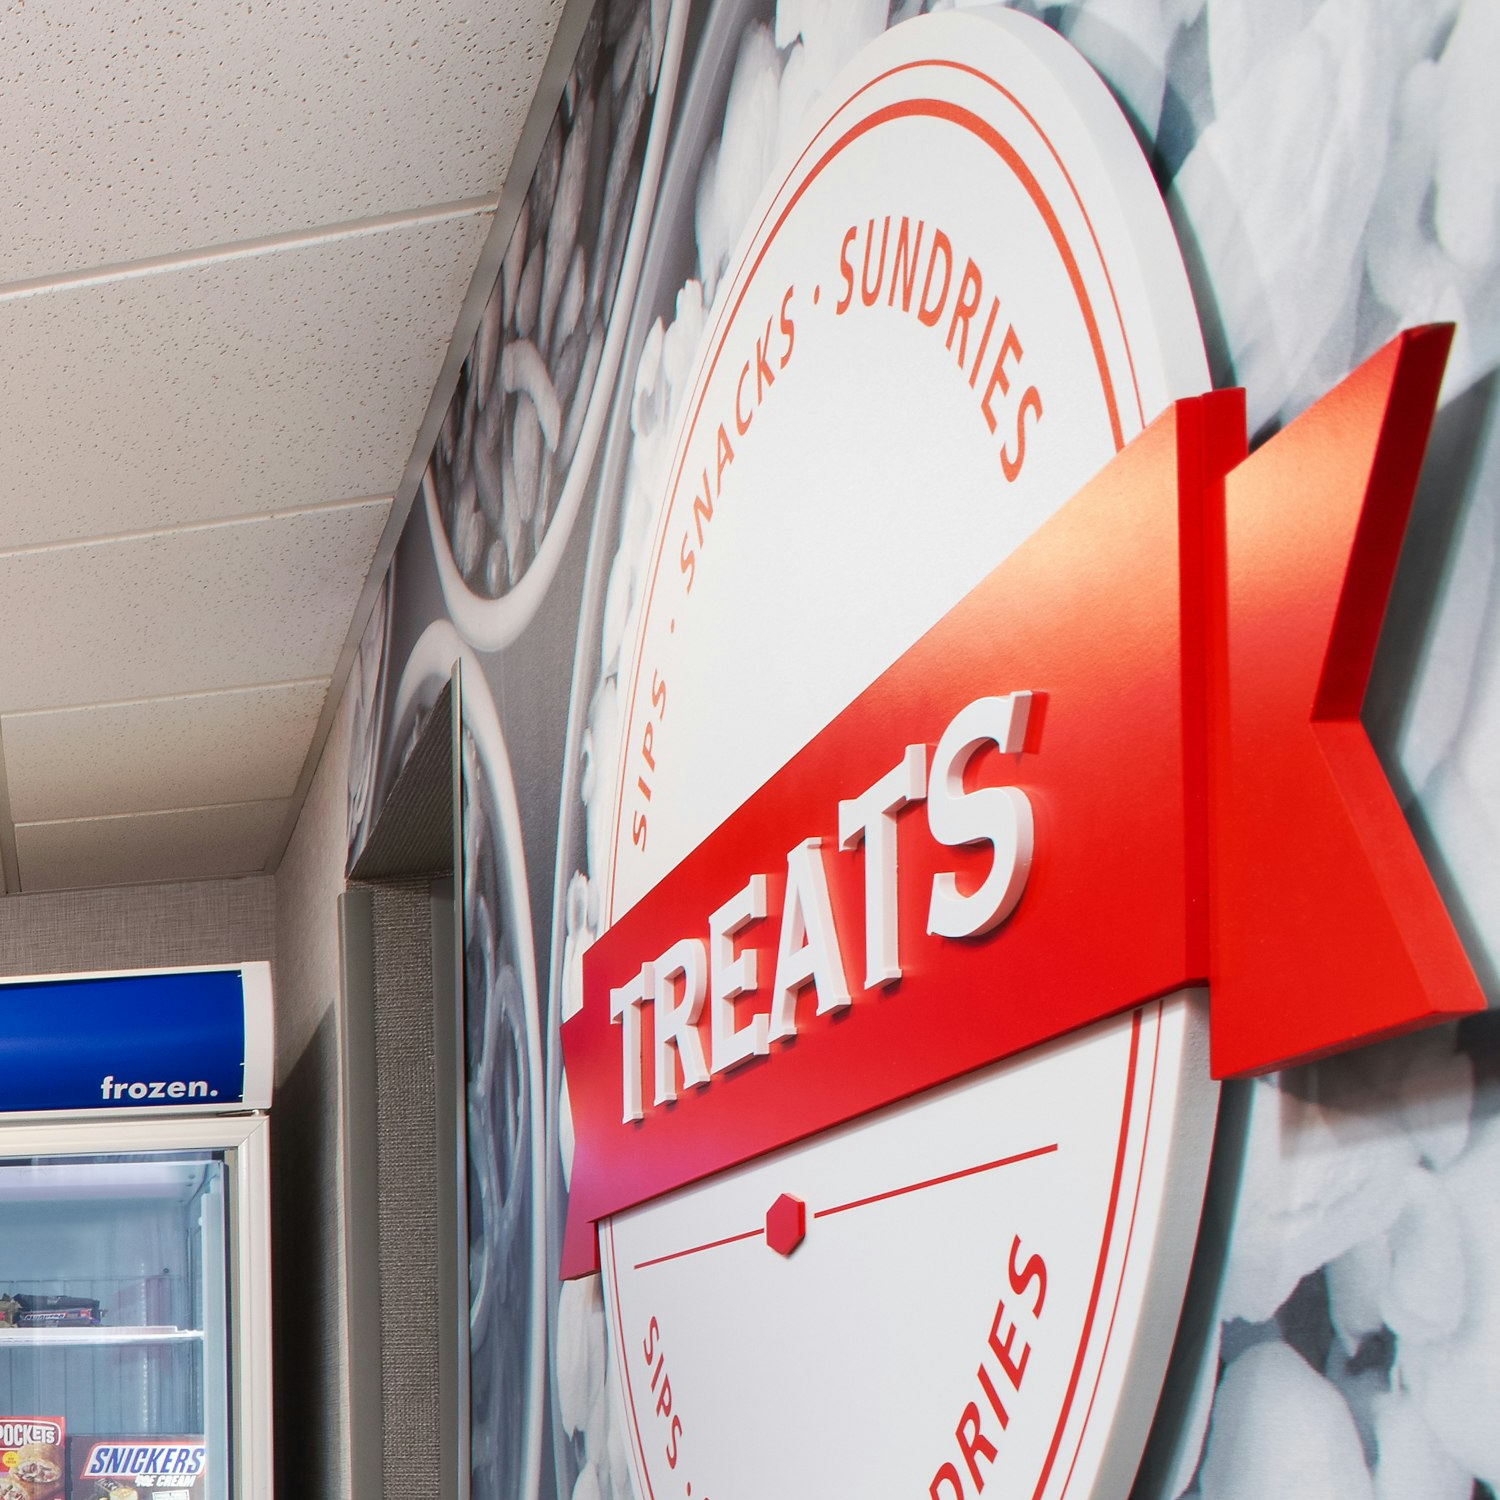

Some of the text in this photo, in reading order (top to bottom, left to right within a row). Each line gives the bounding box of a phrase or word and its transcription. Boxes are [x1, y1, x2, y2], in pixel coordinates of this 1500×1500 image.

[632, 214, 1043, 852] SIPS SNACKS SUNDRIES
[608, 688, 1036, 1124] TREATS
[100, 1075, 218, 1101] frozen.
[642, 1312, 683, 1469] SIPS
[91, 1447, 205, 1475] SNICKERS
[156, 1475, 196, 1487] CREAM
